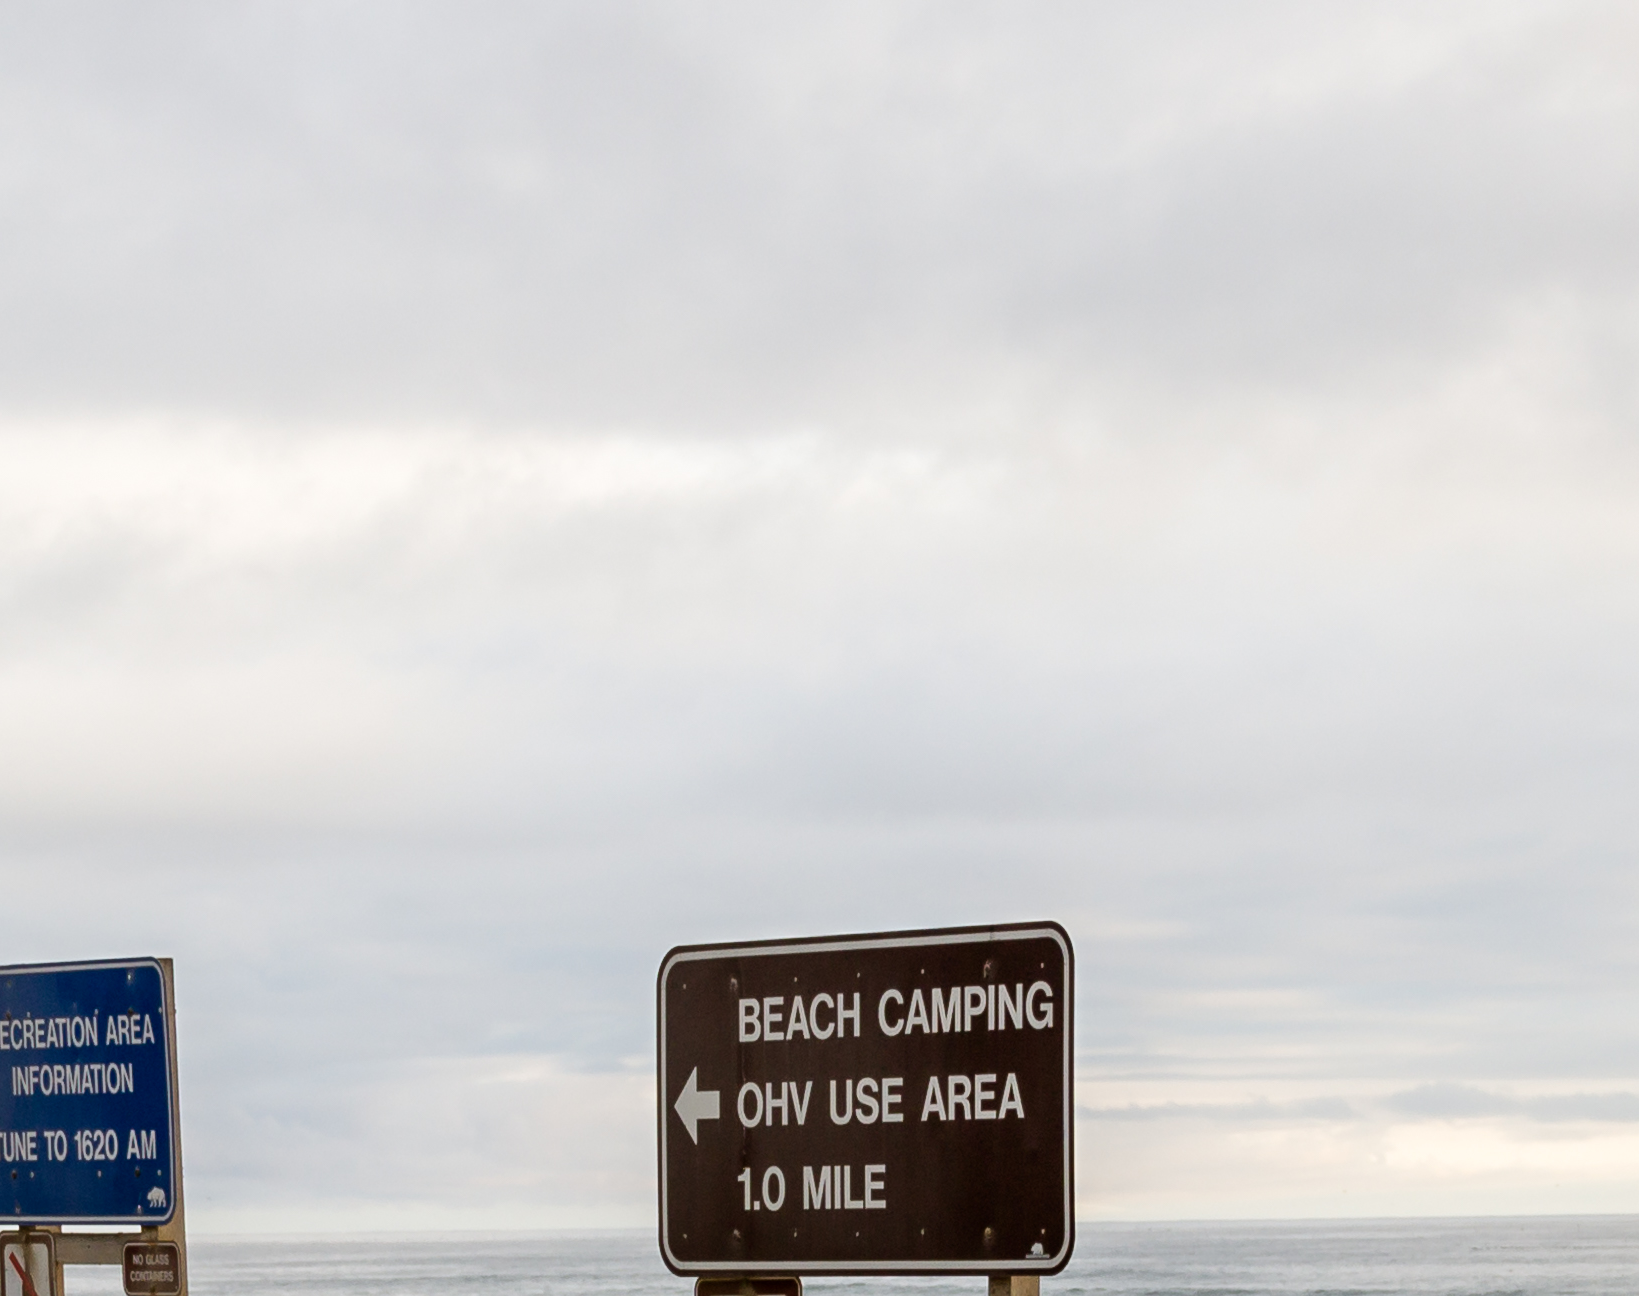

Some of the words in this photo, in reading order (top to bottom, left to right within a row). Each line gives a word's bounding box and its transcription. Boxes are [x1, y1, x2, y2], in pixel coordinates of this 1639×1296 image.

[738, 992, 860, 1043] BEACH
[878, 981, 1053, 1036] CAMPING
[106, 1014, 155, 1045] AREA
[12, 1063, 134, 1096] INFORMATION
[737, 1080, 813, 1128] OHV
[829, 1078, 904, 1125] USE
[921, 1073, 1025, 1122] AREA
[44, 1130, 67, 1161] TO
[74, 1129, 118, 1161] 1620
[127, 1130, 156, 1160] AM
[738, 1165, 785, 1212] 1.0
[803, 1164, 886, 1210] MILE
[133, 1254, 143, 1265] NO
